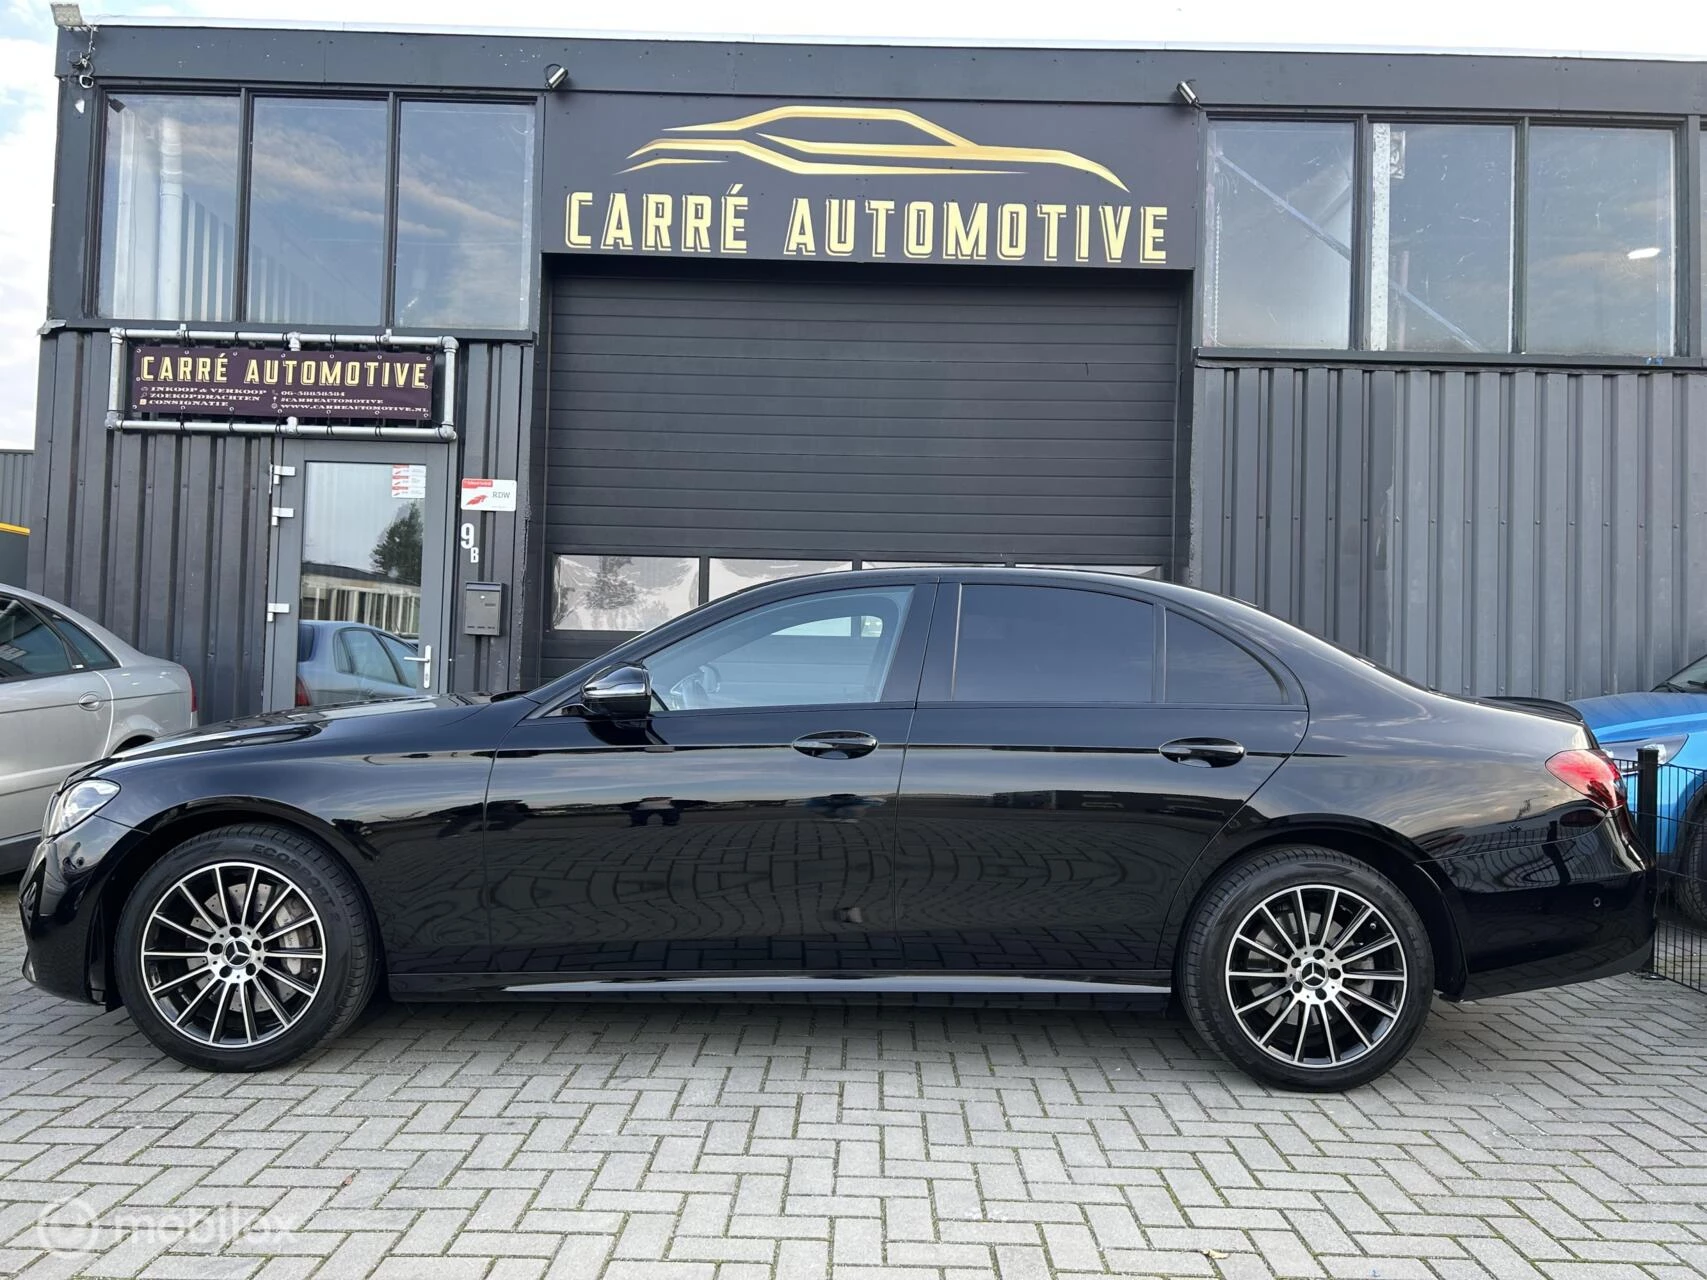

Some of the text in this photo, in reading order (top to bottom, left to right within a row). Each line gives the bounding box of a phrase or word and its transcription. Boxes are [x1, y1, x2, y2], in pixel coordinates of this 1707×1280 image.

[564, 184, 1168, 264] CARRÉ AUTOMOTIVE
[140, 353, 427, 389] CARRÉ AUTOMOTIVE
[149, 393, 261, 401] ZOEKOPDRACHTEN
[210, 387, 267, 395] VERKOOP
[461, 523, 474, 549] 9
[470, 547, 479, 563] B
